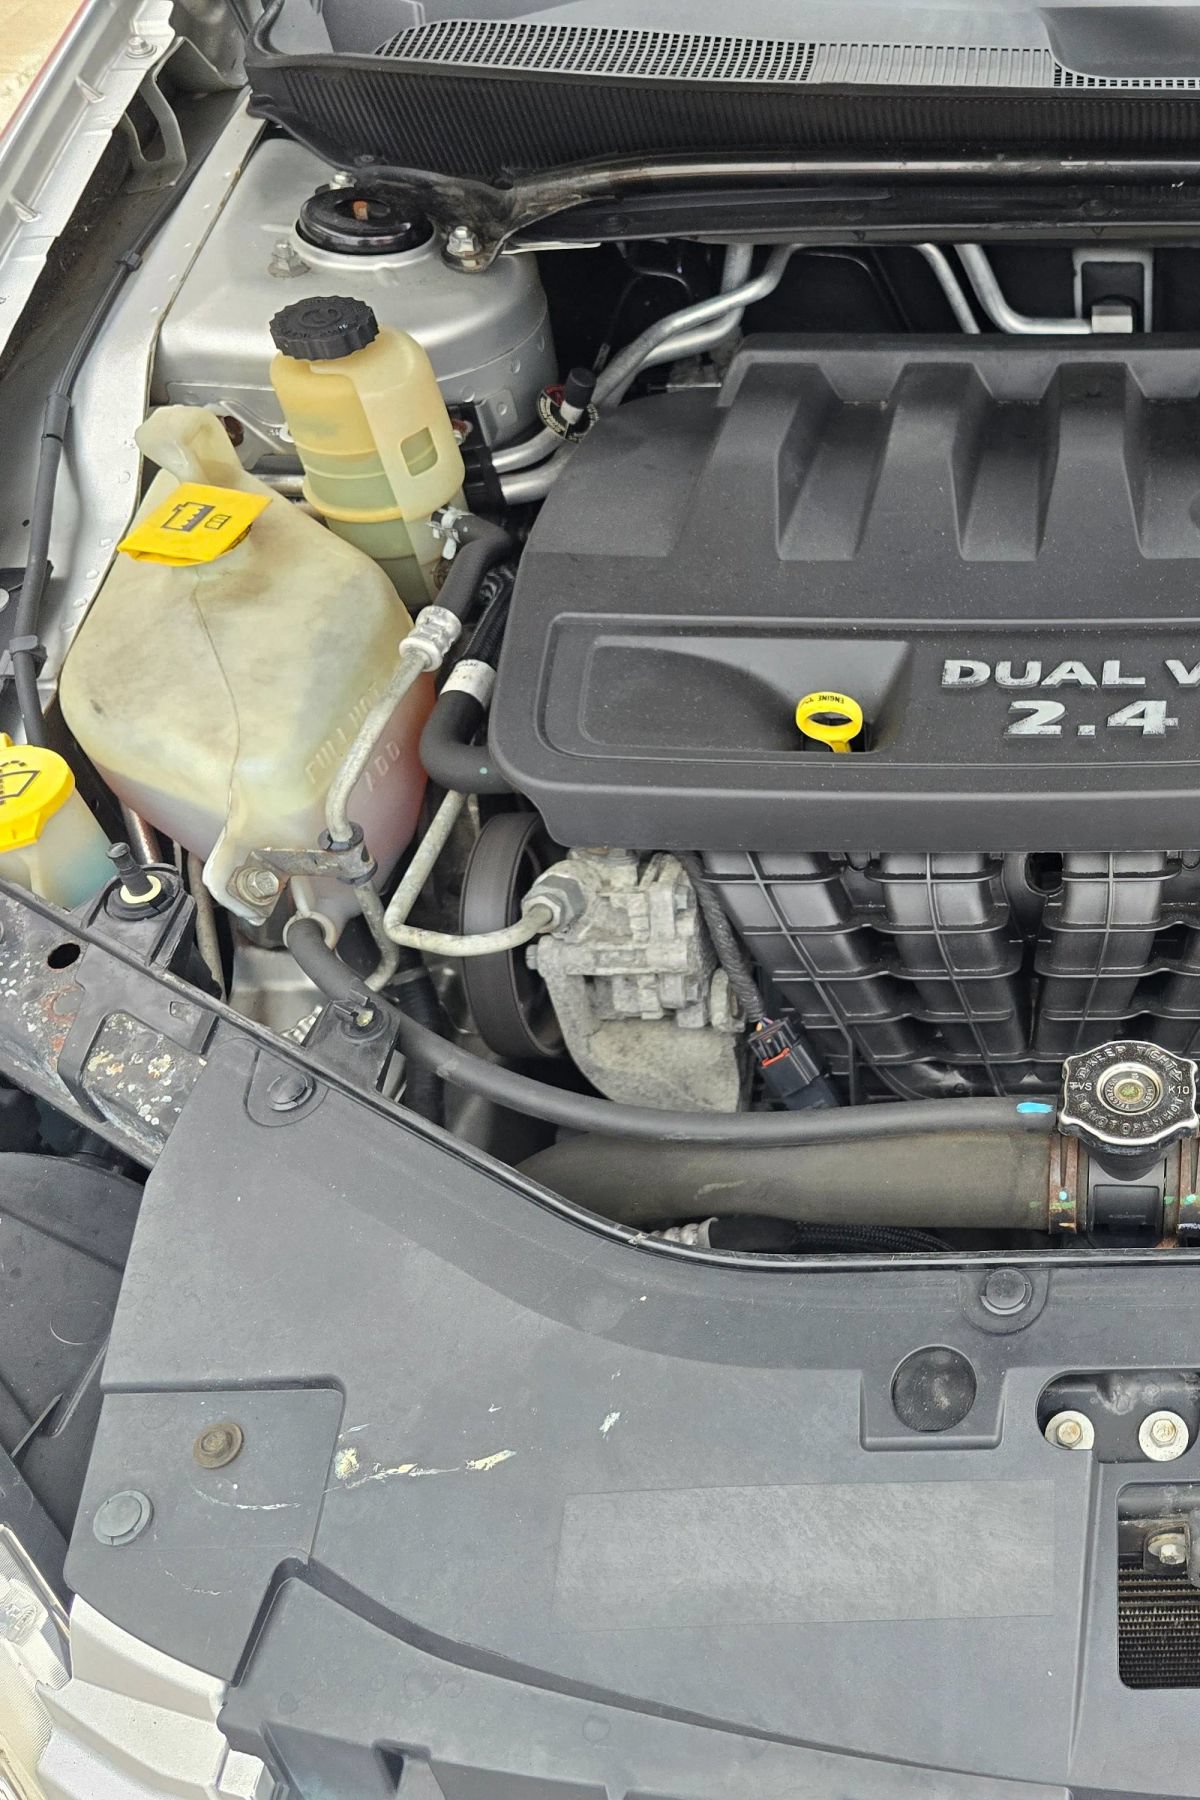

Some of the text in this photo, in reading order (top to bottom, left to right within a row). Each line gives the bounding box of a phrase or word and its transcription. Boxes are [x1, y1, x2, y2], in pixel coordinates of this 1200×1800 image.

[941, 659, 1147, 688] DUAL
[1003, 699, 1179, 739] 2.4
[1088, 1045, 1178, 1073] KEEP TIGHT
[1168, 1085, 1190, 1096] K10
